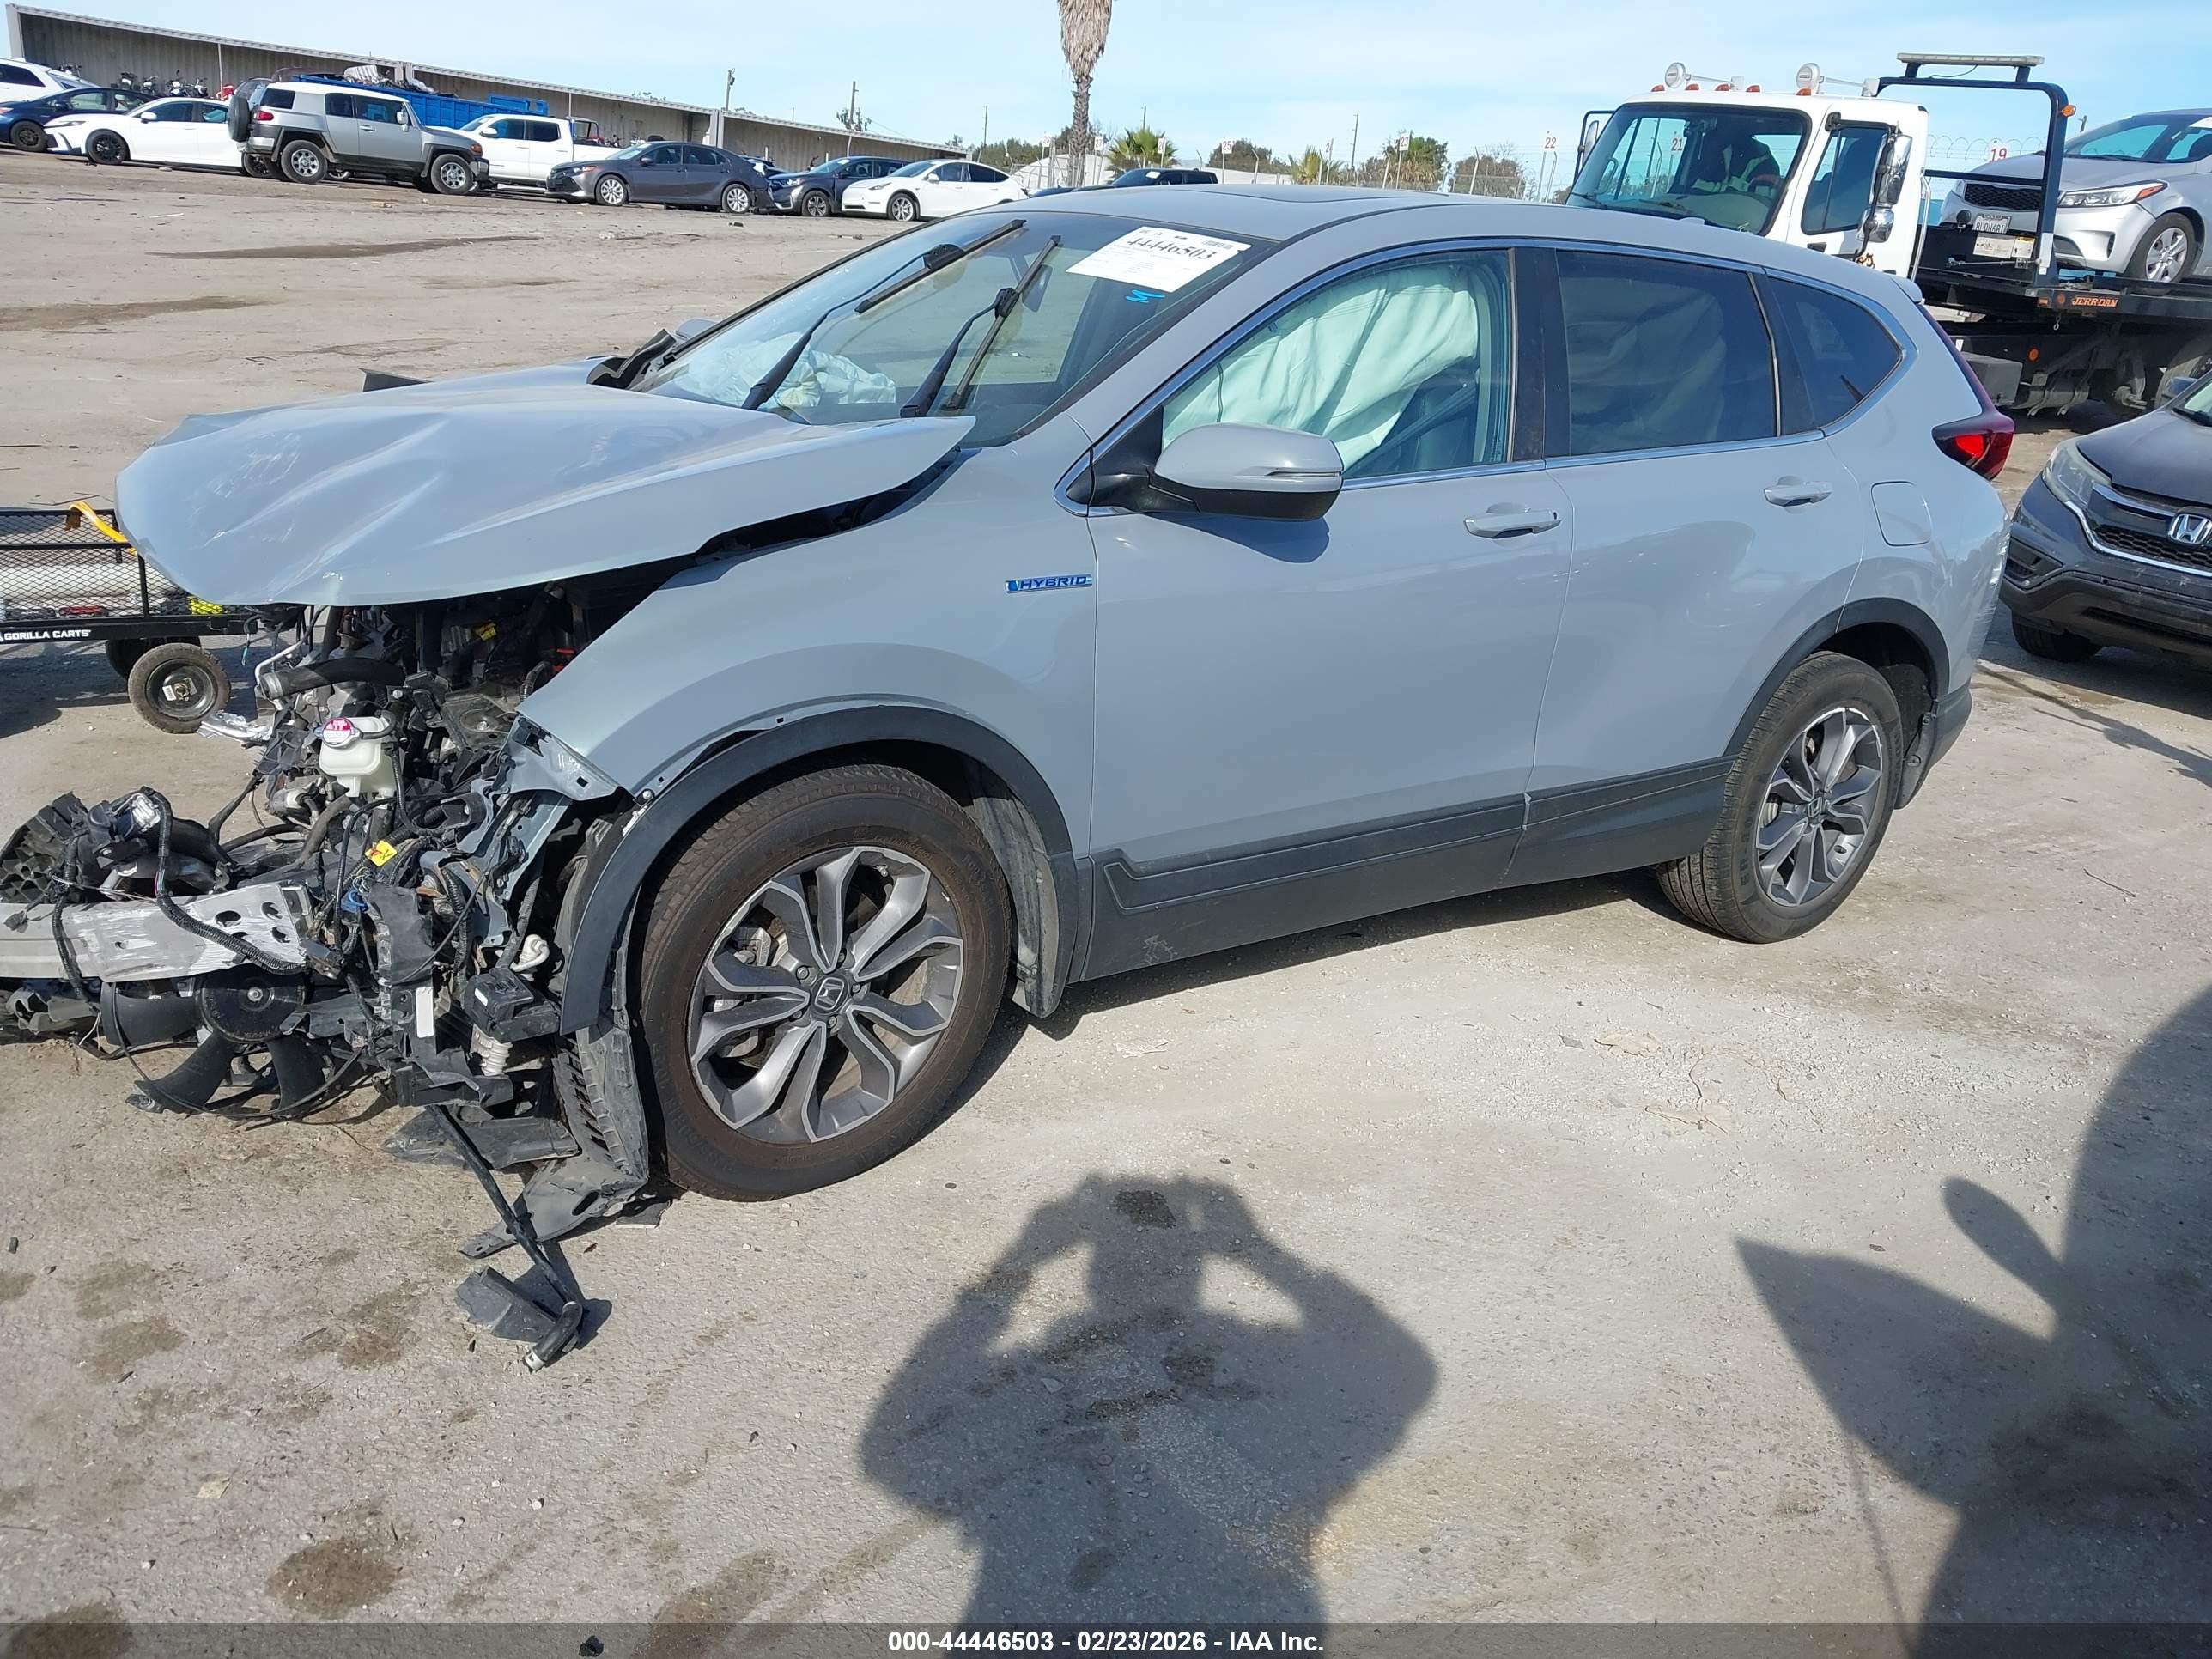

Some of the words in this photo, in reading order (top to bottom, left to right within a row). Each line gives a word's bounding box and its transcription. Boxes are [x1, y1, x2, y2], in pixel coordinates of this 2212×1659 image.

[1223, 141, 1231, 151] 25
[1400, 136, 1409, 147] 23
[1545, 137, 1557, 149] 22
[1671, 138, 1683, 151] 21
[1990, 148, 2008, 161] 19
[1127, 237, 1218, 260] 44446503
[1020, 576, 1087, 589] HYBRID
[3, 631, 51, 641] GORILLA
